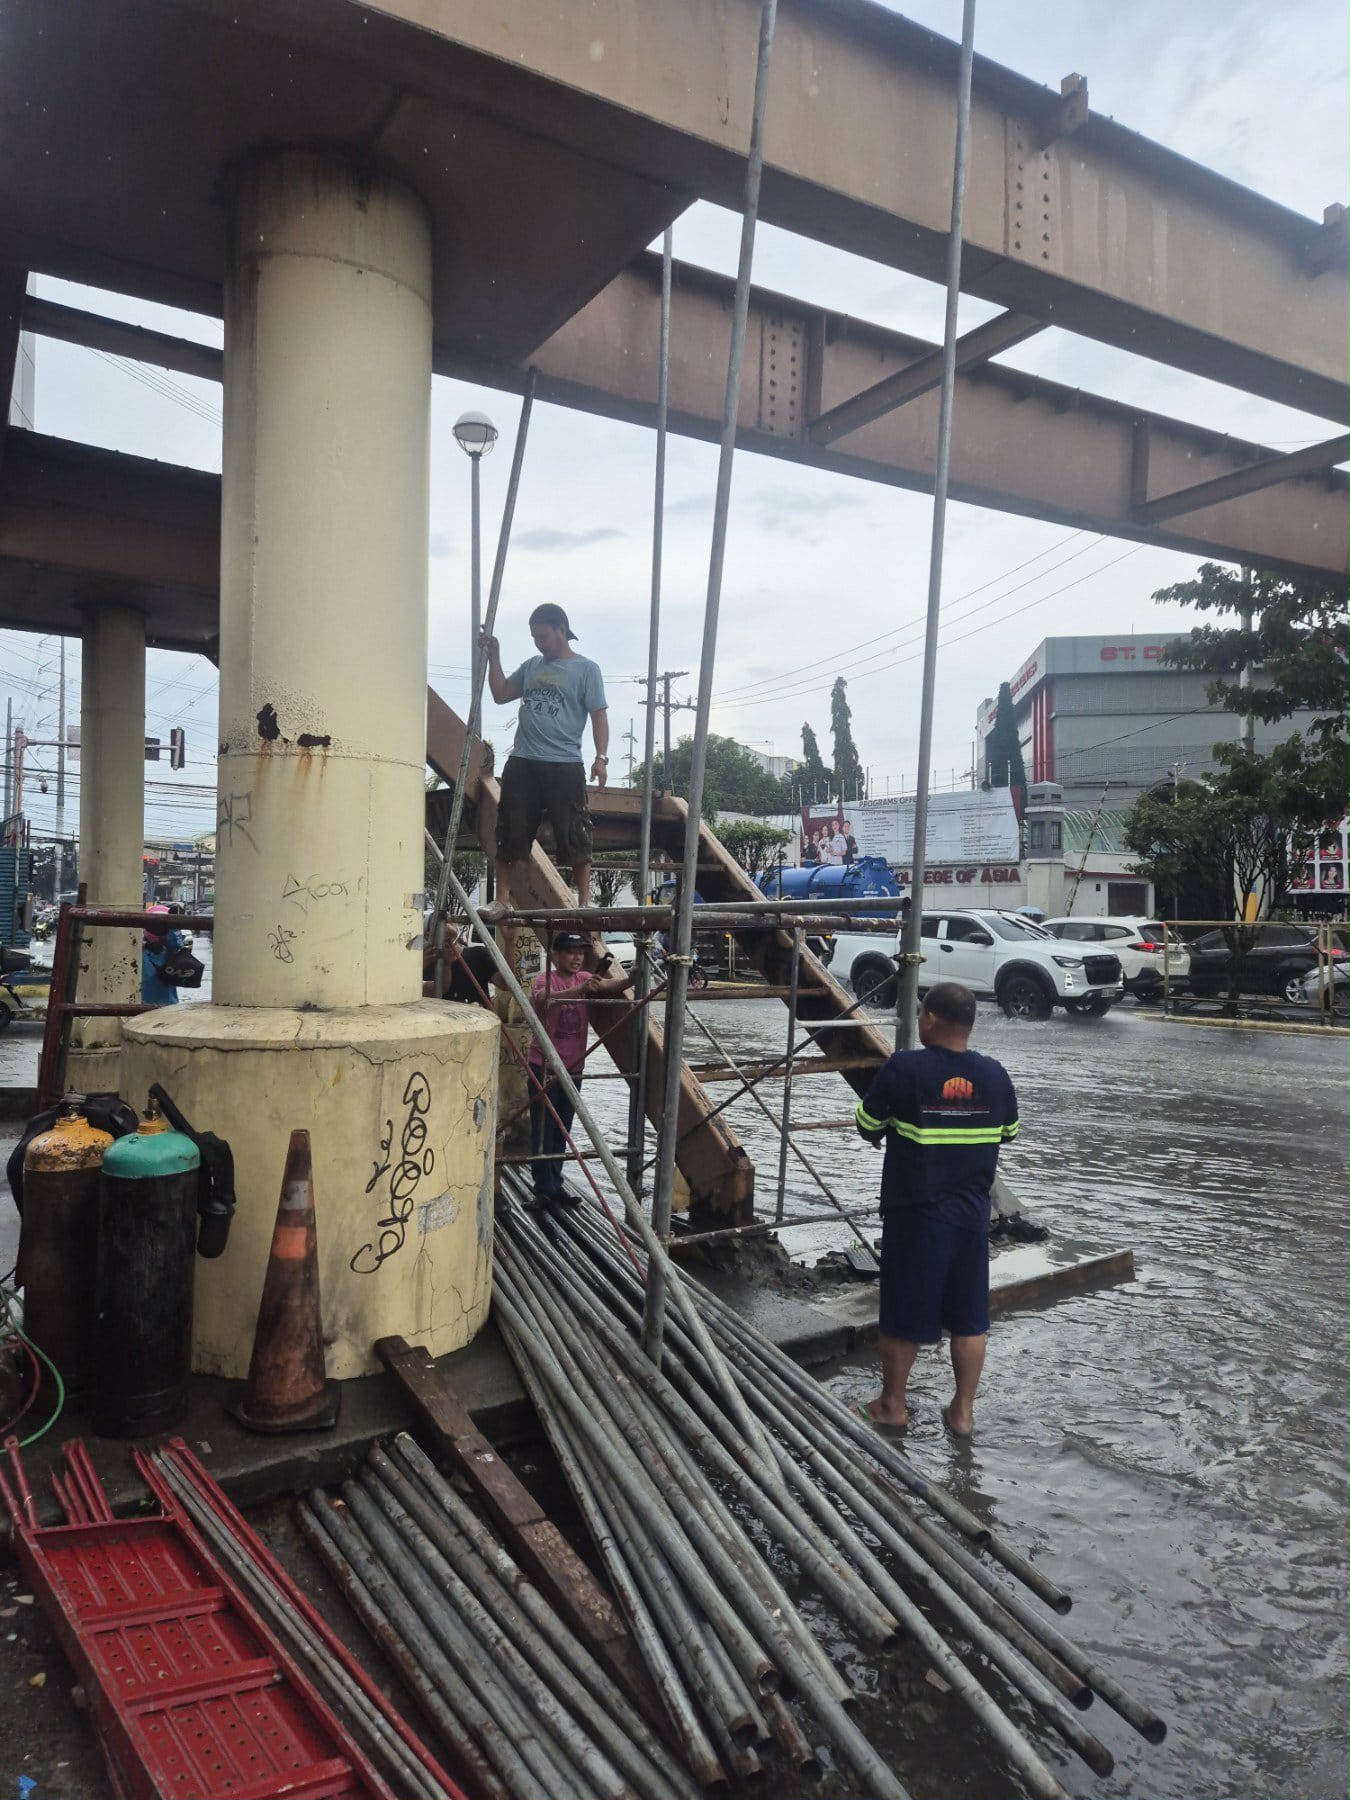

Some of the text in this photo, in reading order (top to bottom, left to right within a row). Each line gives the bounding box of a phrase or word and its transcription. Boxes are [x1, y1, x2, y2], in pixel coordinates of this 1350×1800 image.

[1100, 646, 1136, 661] ST.
[859, 797, 897, 809] PROGRAMS
[896, 868, 1020, 885] OLEGE OF ASIA
